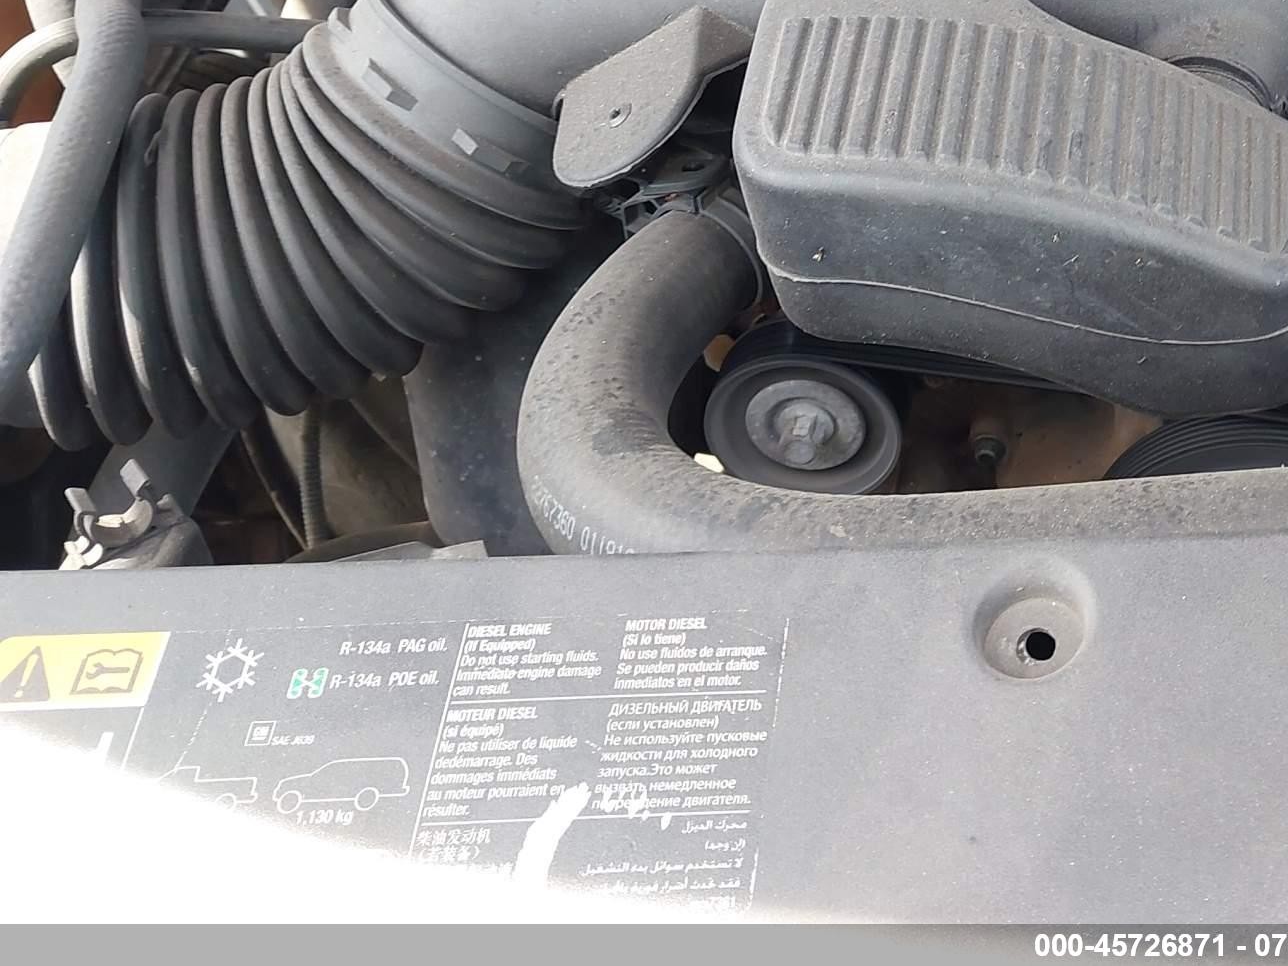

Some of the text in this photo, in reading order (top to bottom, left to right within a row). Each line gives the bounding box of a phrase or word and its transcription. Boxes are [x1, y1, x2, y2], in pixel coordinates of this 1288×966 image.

[468, 623, 552, 637] DIESEL ENGINE
[625, 618, 708, 631] MOTOR DIESEL
[339, 637, 447, 655] R-134a PAG oil.
[479, 638, 536, 653] Equipped)
[623, 633, 686, 647] (Si lo tiene)
[461, 650, 599, 666] Do not use starting fluids.
[620, 645, 767, 660] No use fluidos de arranque.
[457, 665, 601, 681] Immediate engine damage
[617, 658, 760, 676] Se pueden producir daños
[330, 673, 381, 689] R-134a
[388, 671, 418, 686] POE
[420, 670, 439, 685] oil.
[614, 675, 741, 689] inmediatos en el motor.
[453, 685, 473, 696] can
[446, 707, 538, 722] MOTEUR DIESEL
[608, 699, 762, 717] ДИЗЕЛЬНЫЙ ДВИГАТЕЛЬ
[607, 715, 719, 732] (если установлен)
[443, 725, 458, 739] (si
[604, 731, 768, 747] Не используйте пусковые
[439, 735, 577, 754] Ne pas utiliser de liquide
[601, 747, 758, 762] жидкости для холодного
[431, 768, 557, 785] dommages immédiats
[675, 763, 718, 775] может
[427, 790, 442, 801] au
[444, 787, 486, 800] moteur
[488, 783, 548, 800] pourraient
[649, 779, 736, 791] немедленное
[335, 810, 354, 825] kg
